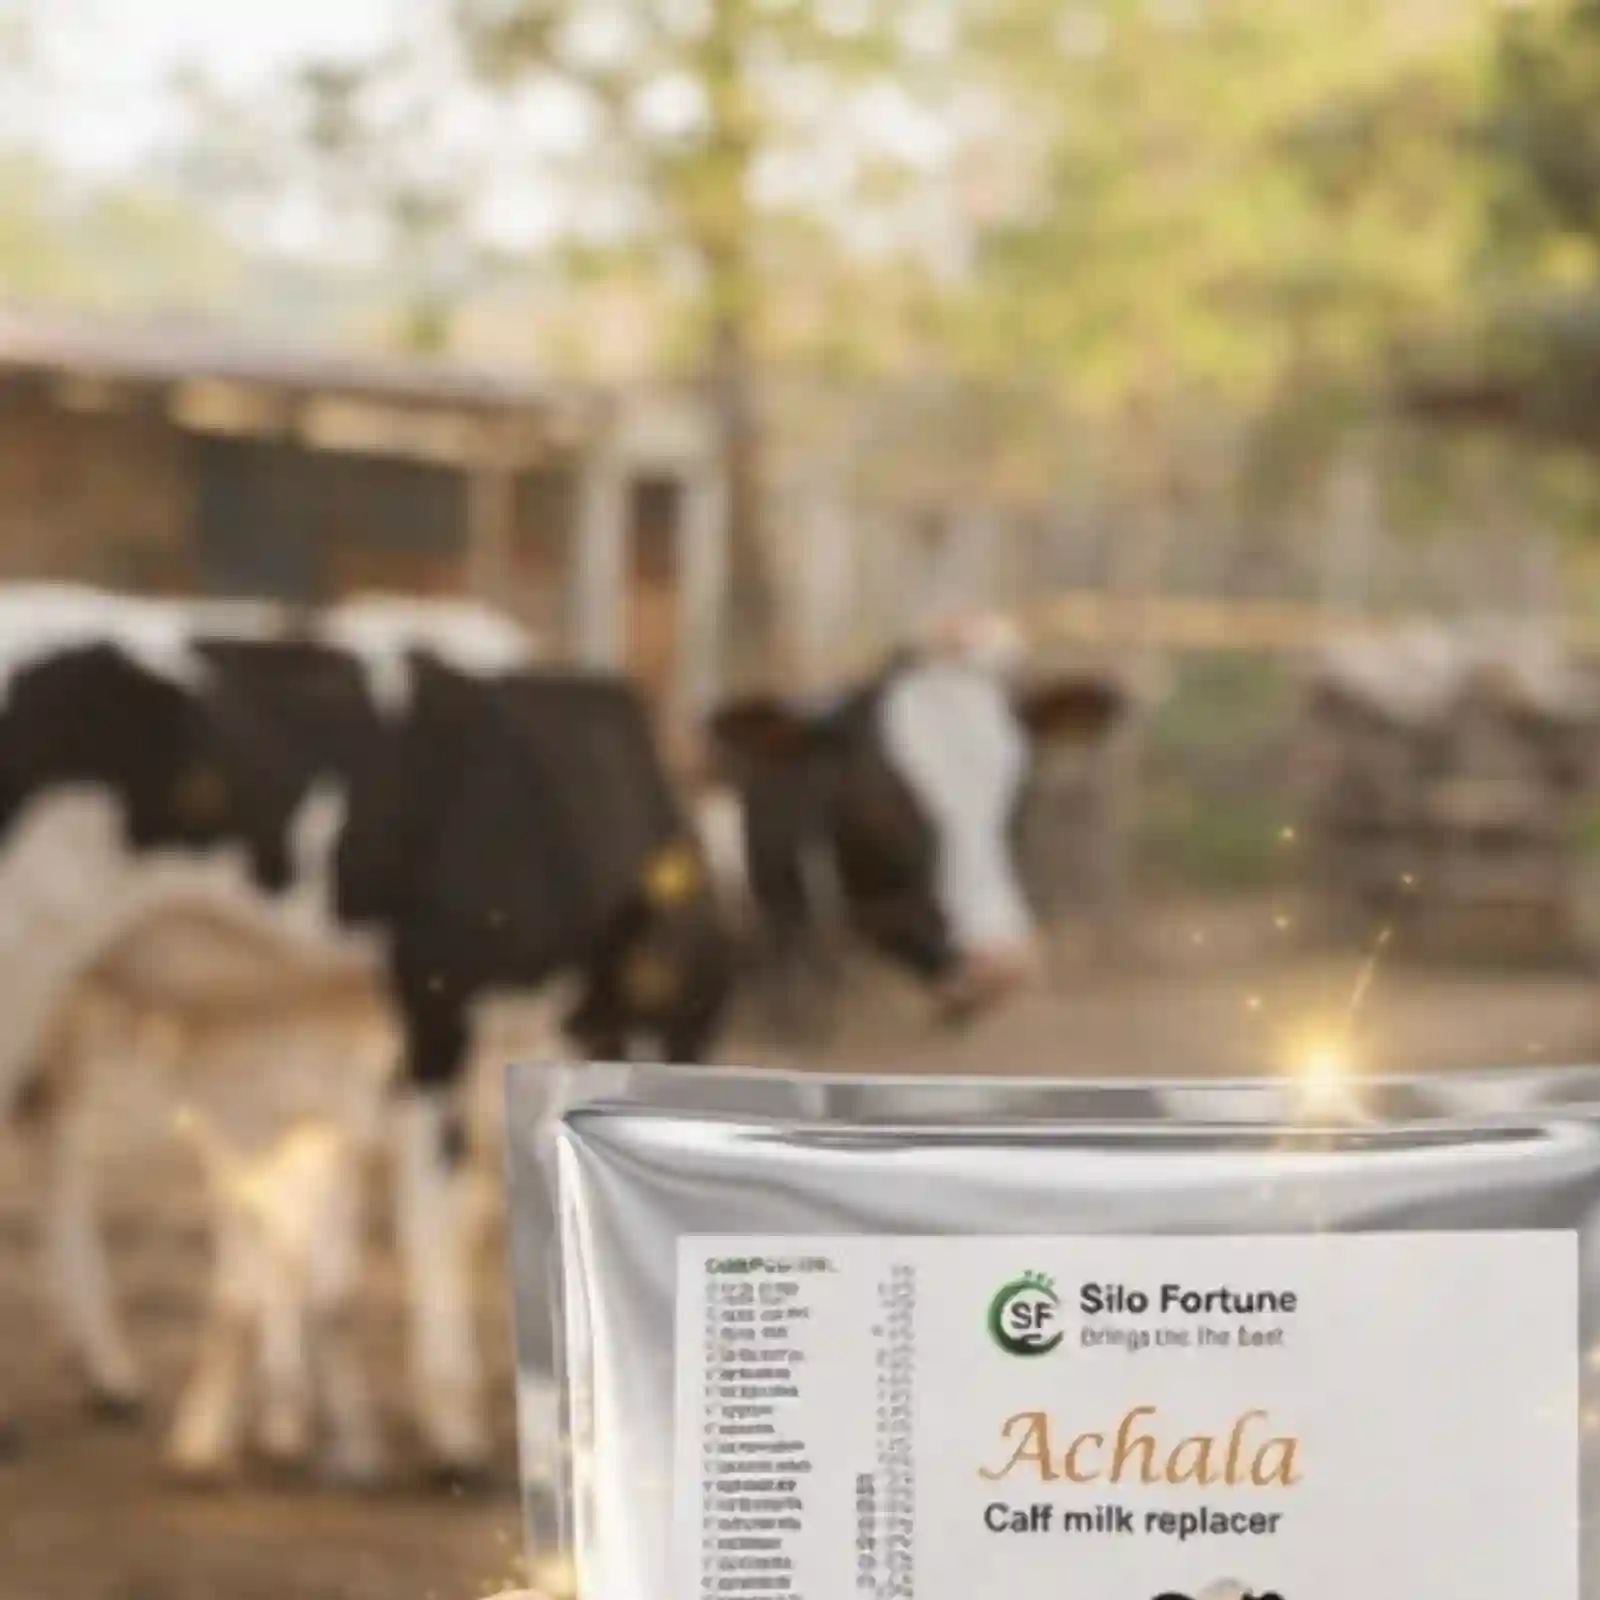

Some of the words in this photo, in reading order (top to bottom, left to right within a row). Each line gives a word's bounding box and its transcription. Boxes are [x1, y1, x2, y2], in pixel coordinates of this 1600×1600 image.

[1010, 1302, 1054, 1330] SF
[1079, 1282, 1150, 1315] Silo
[1160, 1283, 1299, 1315] Fortune
[978, 1404, 1304, 1488] Achala
[983, 1502, 1054, 1534] Calf
[1064, 1504, 1134, 1534] milk
[1144, 1505, 1285, 1541] replacer
